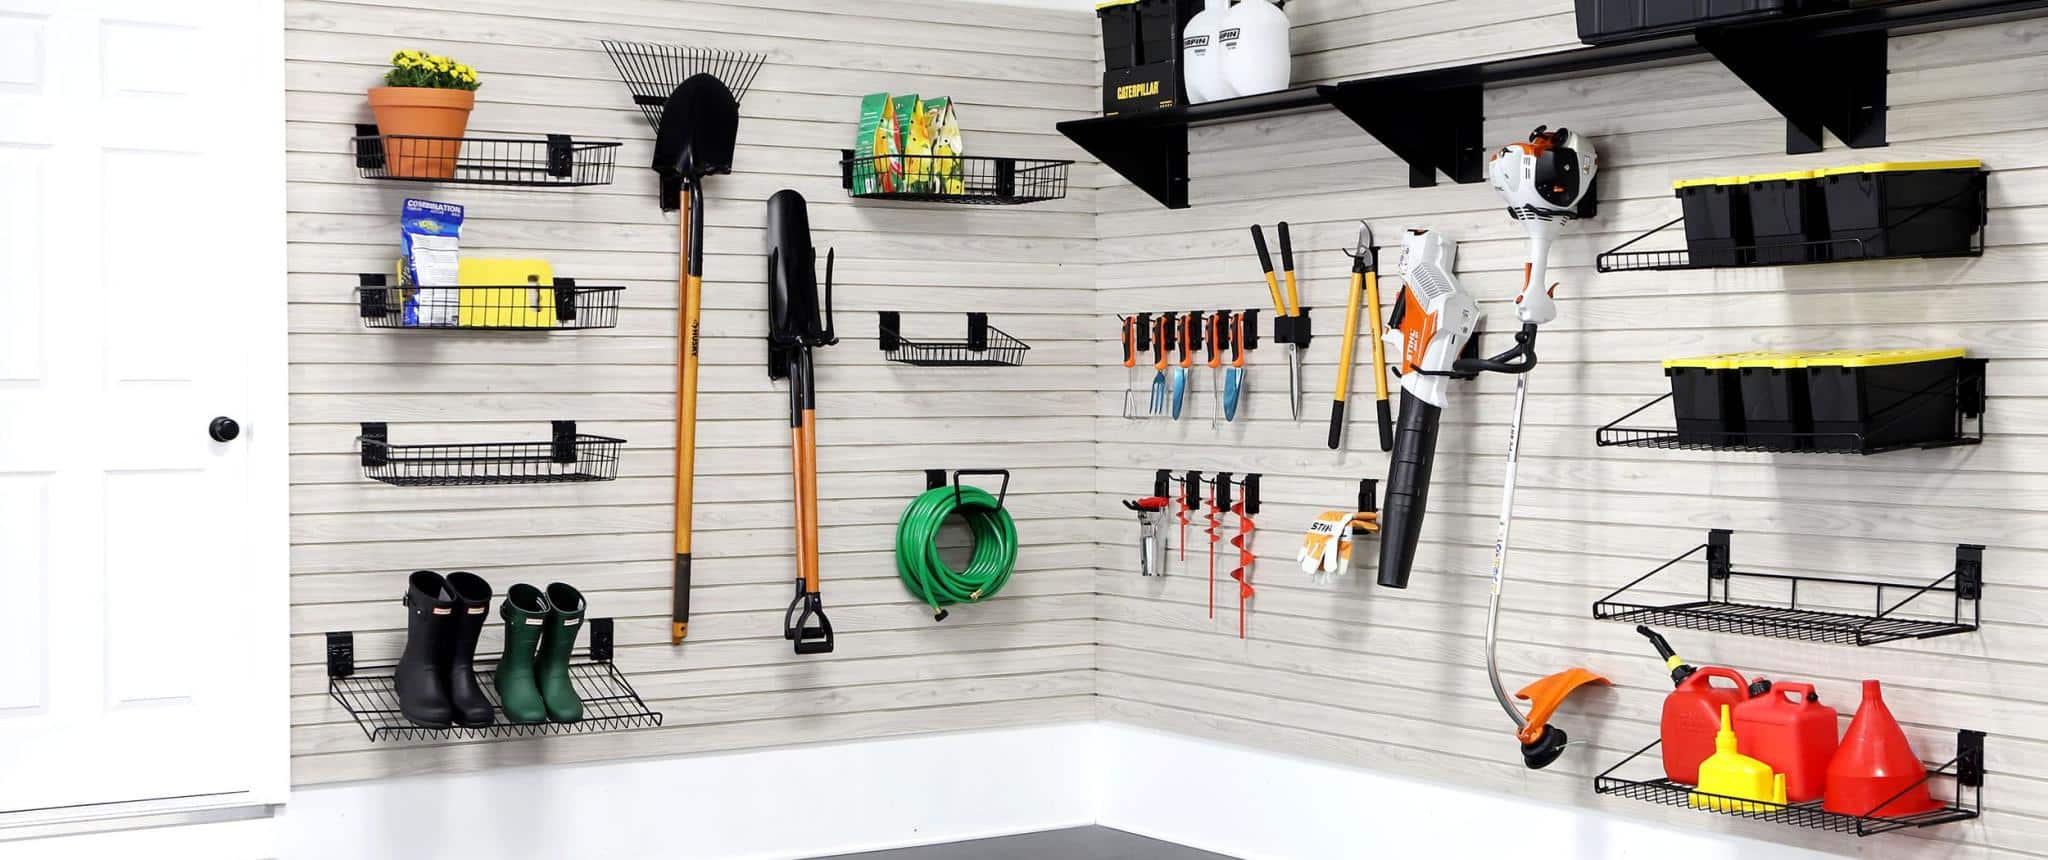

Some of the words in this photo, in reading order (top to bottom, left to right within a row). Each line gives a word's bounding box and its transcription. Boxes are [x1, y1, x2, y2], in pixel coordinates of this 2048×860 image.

[1117, 81, 1160, 100] CATERPILLAR
[407, 199, 461, 214] COMBINATION
[1406, 328, 1416, 361] STIHL
